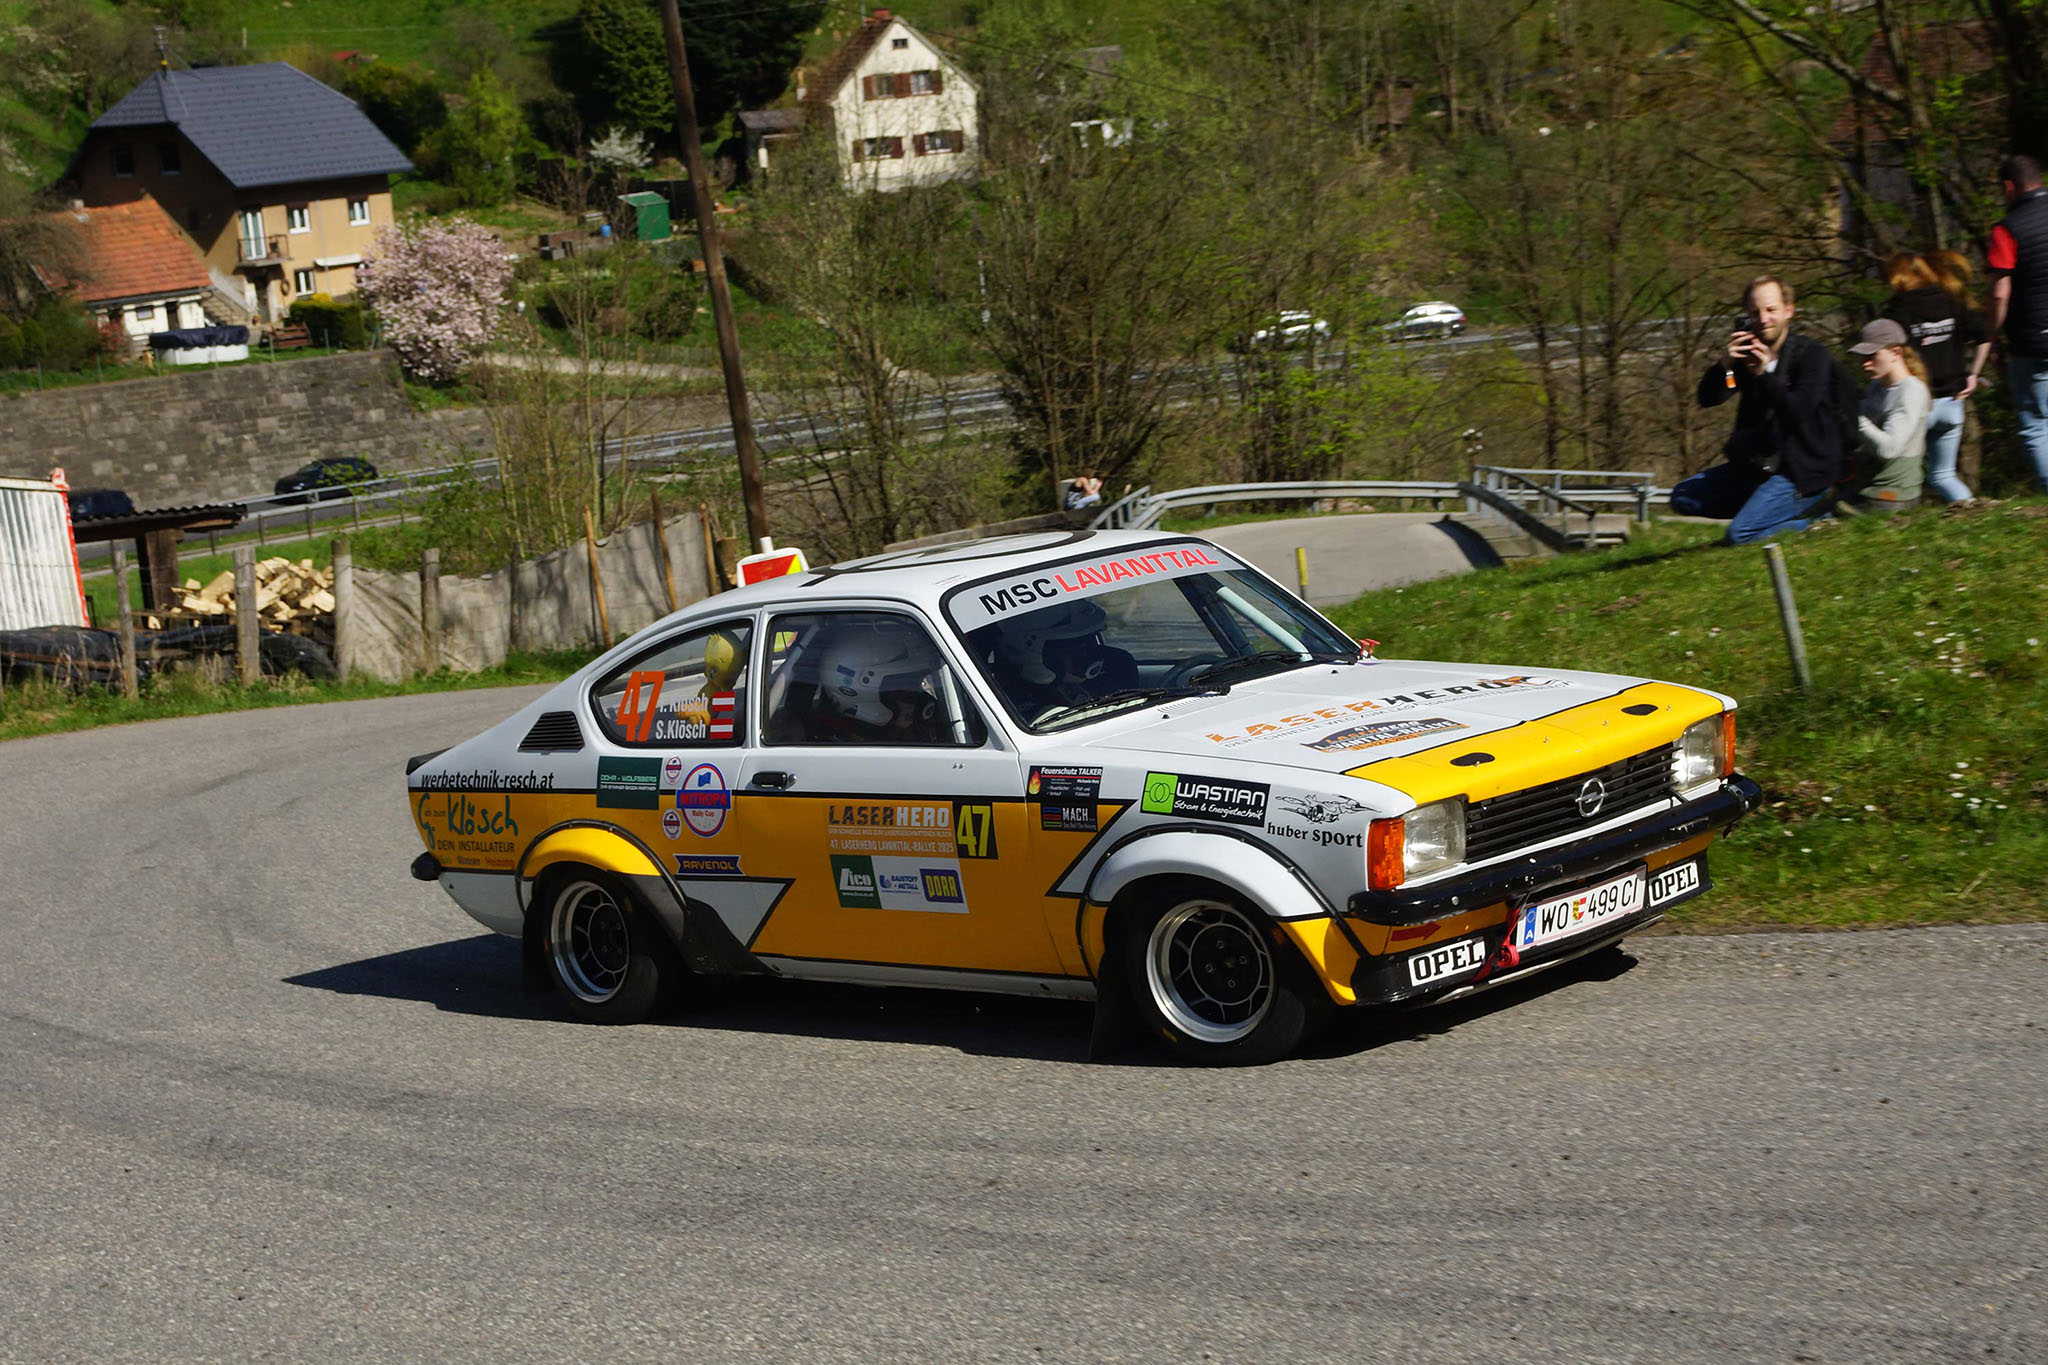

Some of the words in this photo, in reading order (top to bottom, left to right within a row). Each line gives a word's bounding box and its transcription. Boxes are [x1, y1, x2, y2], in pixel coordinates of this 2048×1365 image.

[617, 671, 665, 742] 47
[422, 769, 554, 788] werbetechnik-resch.at
[1078, 768, 1102, 776] TALKER
[680, 793, 728, 805] MITROPA
[1176, 782, 1266, 807] WASTIAN
[829, 805, 949, 827] LASERHERO
[1062, 807, 1089, 821] MACH
[957, 805, 991, 856] 47
[1267, 822, 1308, 840] huber
[1312, 828, 1363, 848] sport
[458, 841, 515, 853] INSTALLATEUR
[683, 860, 736, 870] RAVENOL
[1651, 866, 1697, 901] OPEL
[1541, 902, 1568, 935] WO
[1588, 885, 1619, 919] 499
[1525, 930, 1534, 941] A
[1413, 941, 1483, 980] OPEL
